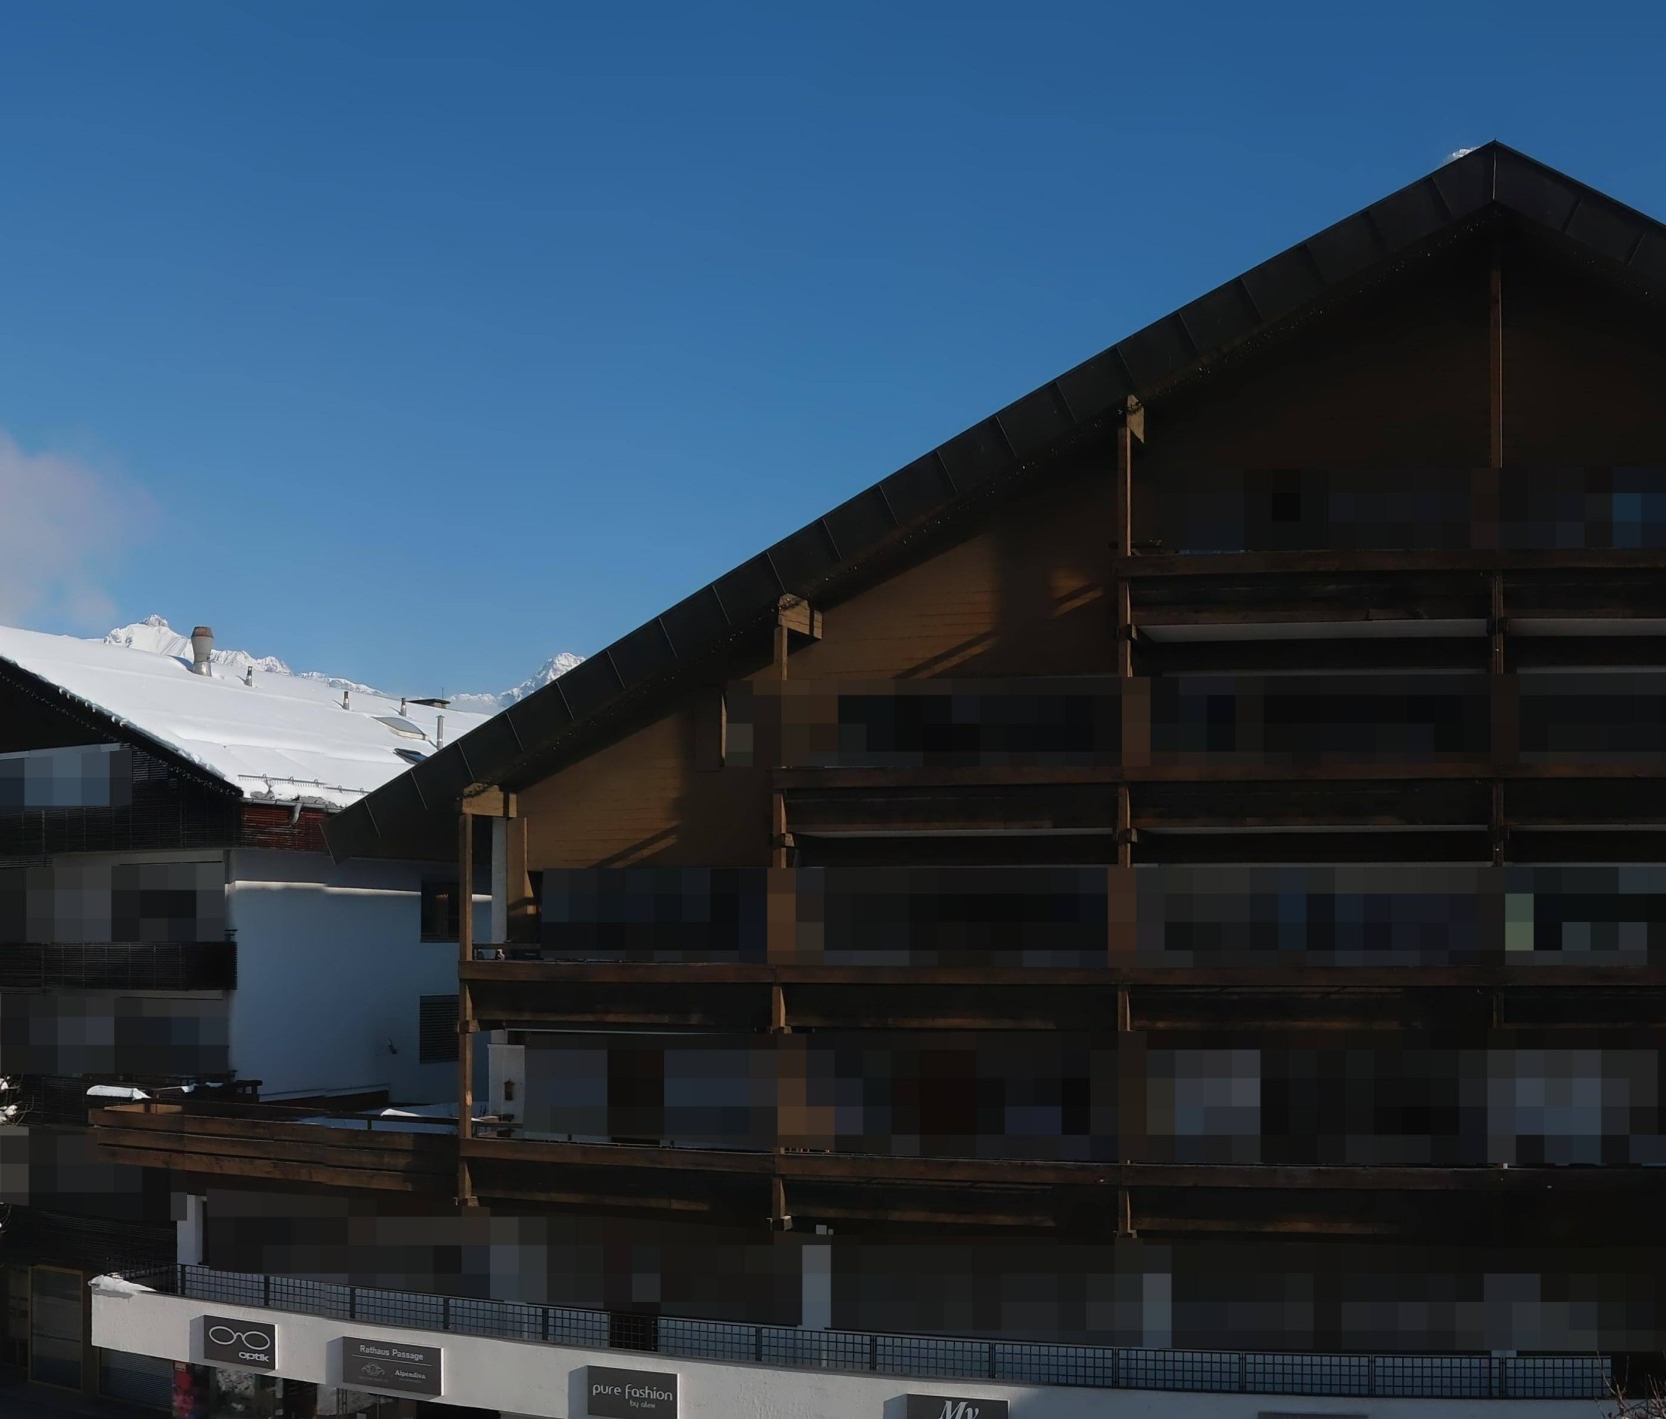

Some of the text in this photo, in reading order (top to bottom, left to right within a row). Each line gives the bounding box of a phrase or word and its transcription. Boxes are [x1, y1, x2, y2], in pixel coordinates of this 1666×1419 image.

[238, 1351, 270, 1363] optik
[359, 1344, 424, 1361] Rathaus Passage
[593, 1384, 673, 1401] pure fashion
[629, 1400, 639, 1409] by
